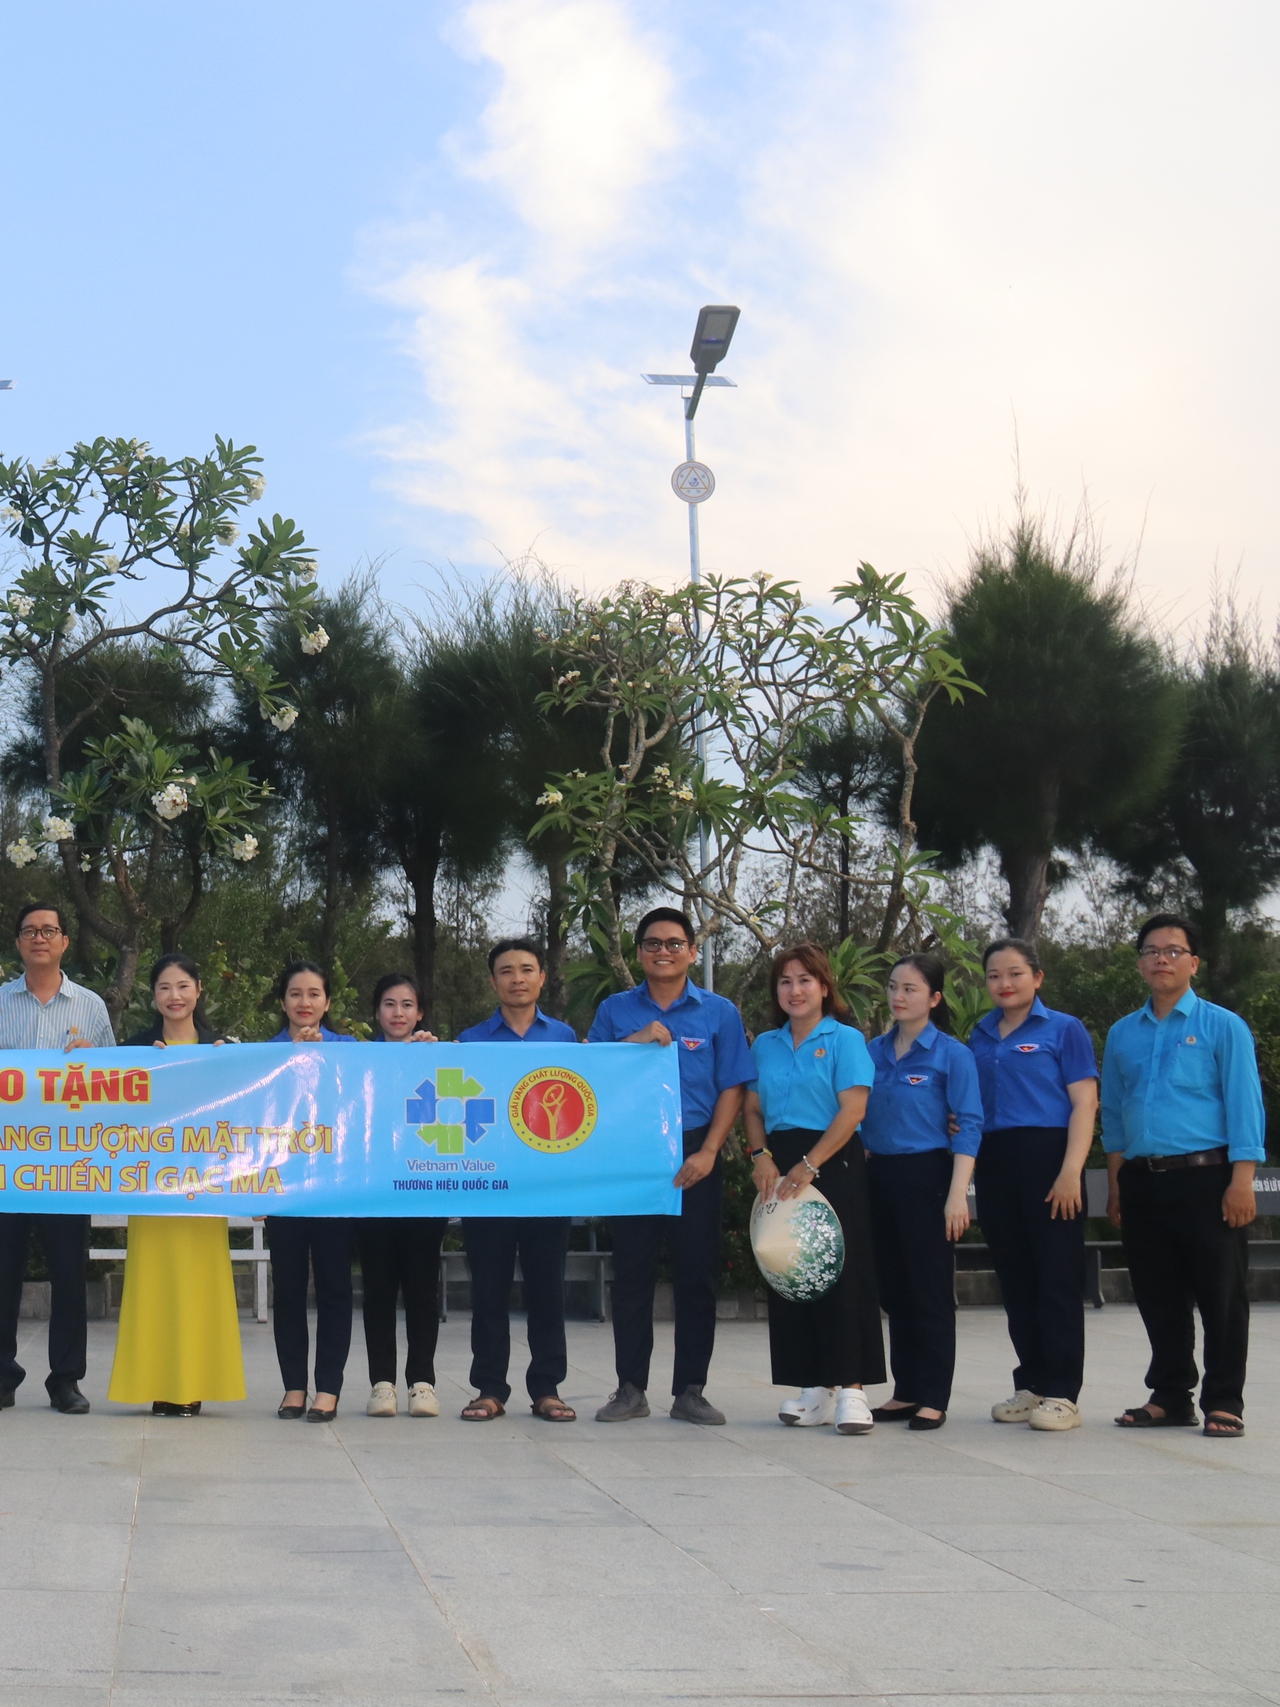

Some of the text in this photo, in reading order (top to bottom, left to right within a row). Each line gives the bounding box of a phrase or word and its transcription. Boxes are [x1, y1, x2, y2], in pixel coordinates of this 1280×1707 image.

[36, 1062, 152, 1112] TẶNG
[510, 1069, 595, 1118] GIẢI VÀNG CHẤT LƯỢNG QUỐC GIA
[58, 1122, 175, 1159] LƯỢNG
[181, 1120, 255, 1160] MẶT
[256, 1121, 334, 1154] TRỜI
[13, 1157, 112, 1193] CHIẾN
[119, 1160, 151, 1193] SĨ
[155, 1166, 225, 1201] GẠC
[230, 1167, 285, 1195] MA
[393, 1176, 509, 1193] THƯƠNG HIỆU QUỐC GIA
[407, 1159, 496, 1172] Vietnam Value
